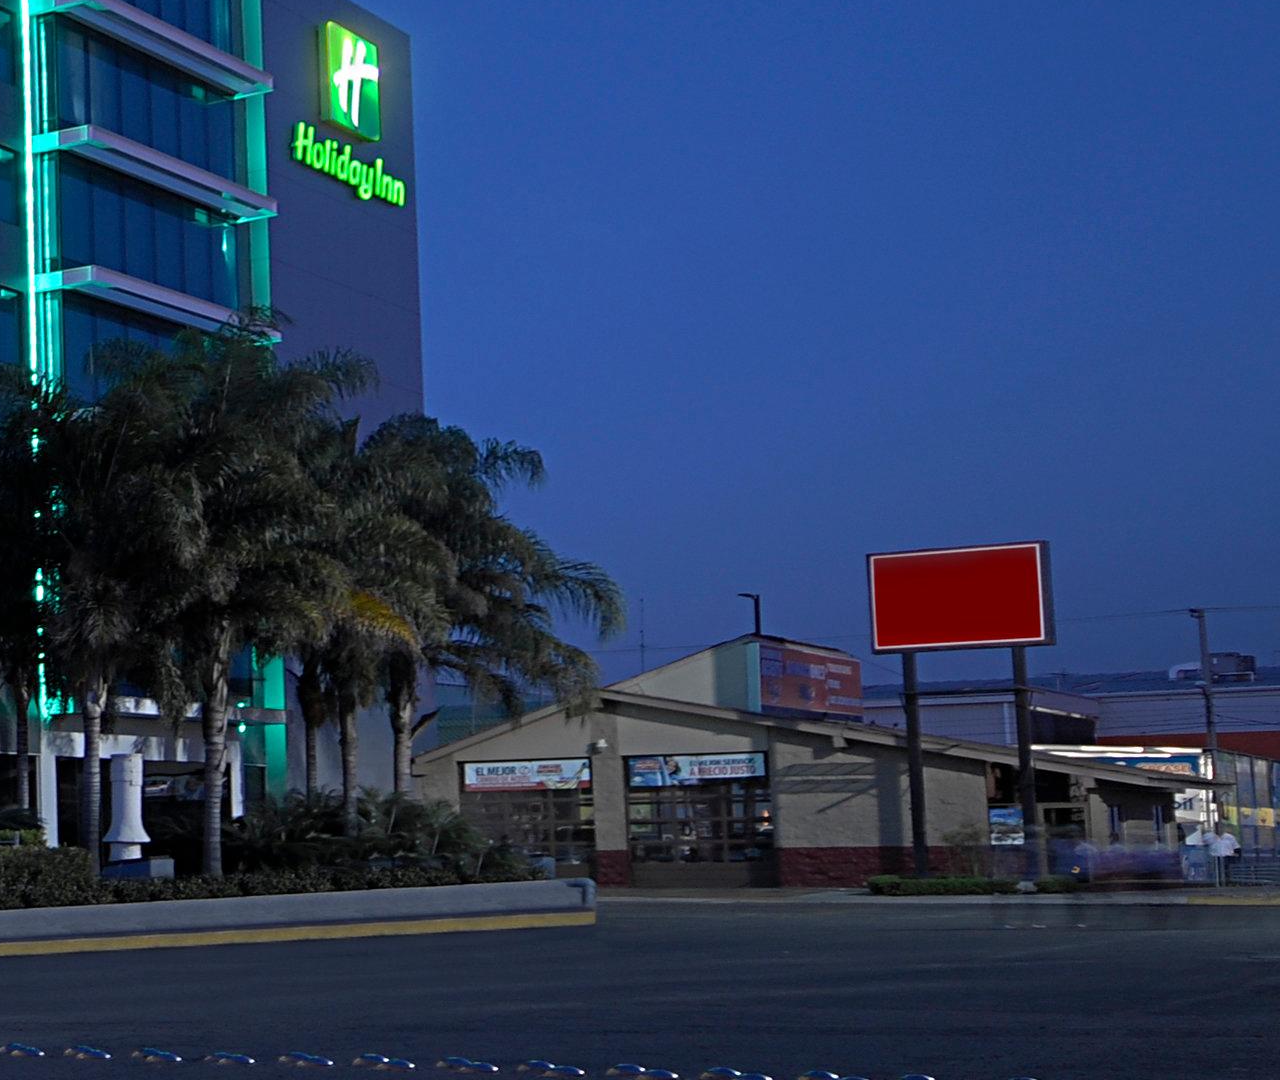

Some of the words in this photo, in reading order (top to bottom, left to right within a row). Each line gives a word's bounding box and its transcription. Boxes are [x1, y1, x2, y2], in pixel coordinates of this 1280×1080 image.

[333, 37, 379, 128] H
[294, 121, 375, 201] Holiday
[375, 157, 406, 207] Inn
[475, 767, 485, 776] EL
[487, 766, 517, 776] MEJOR
